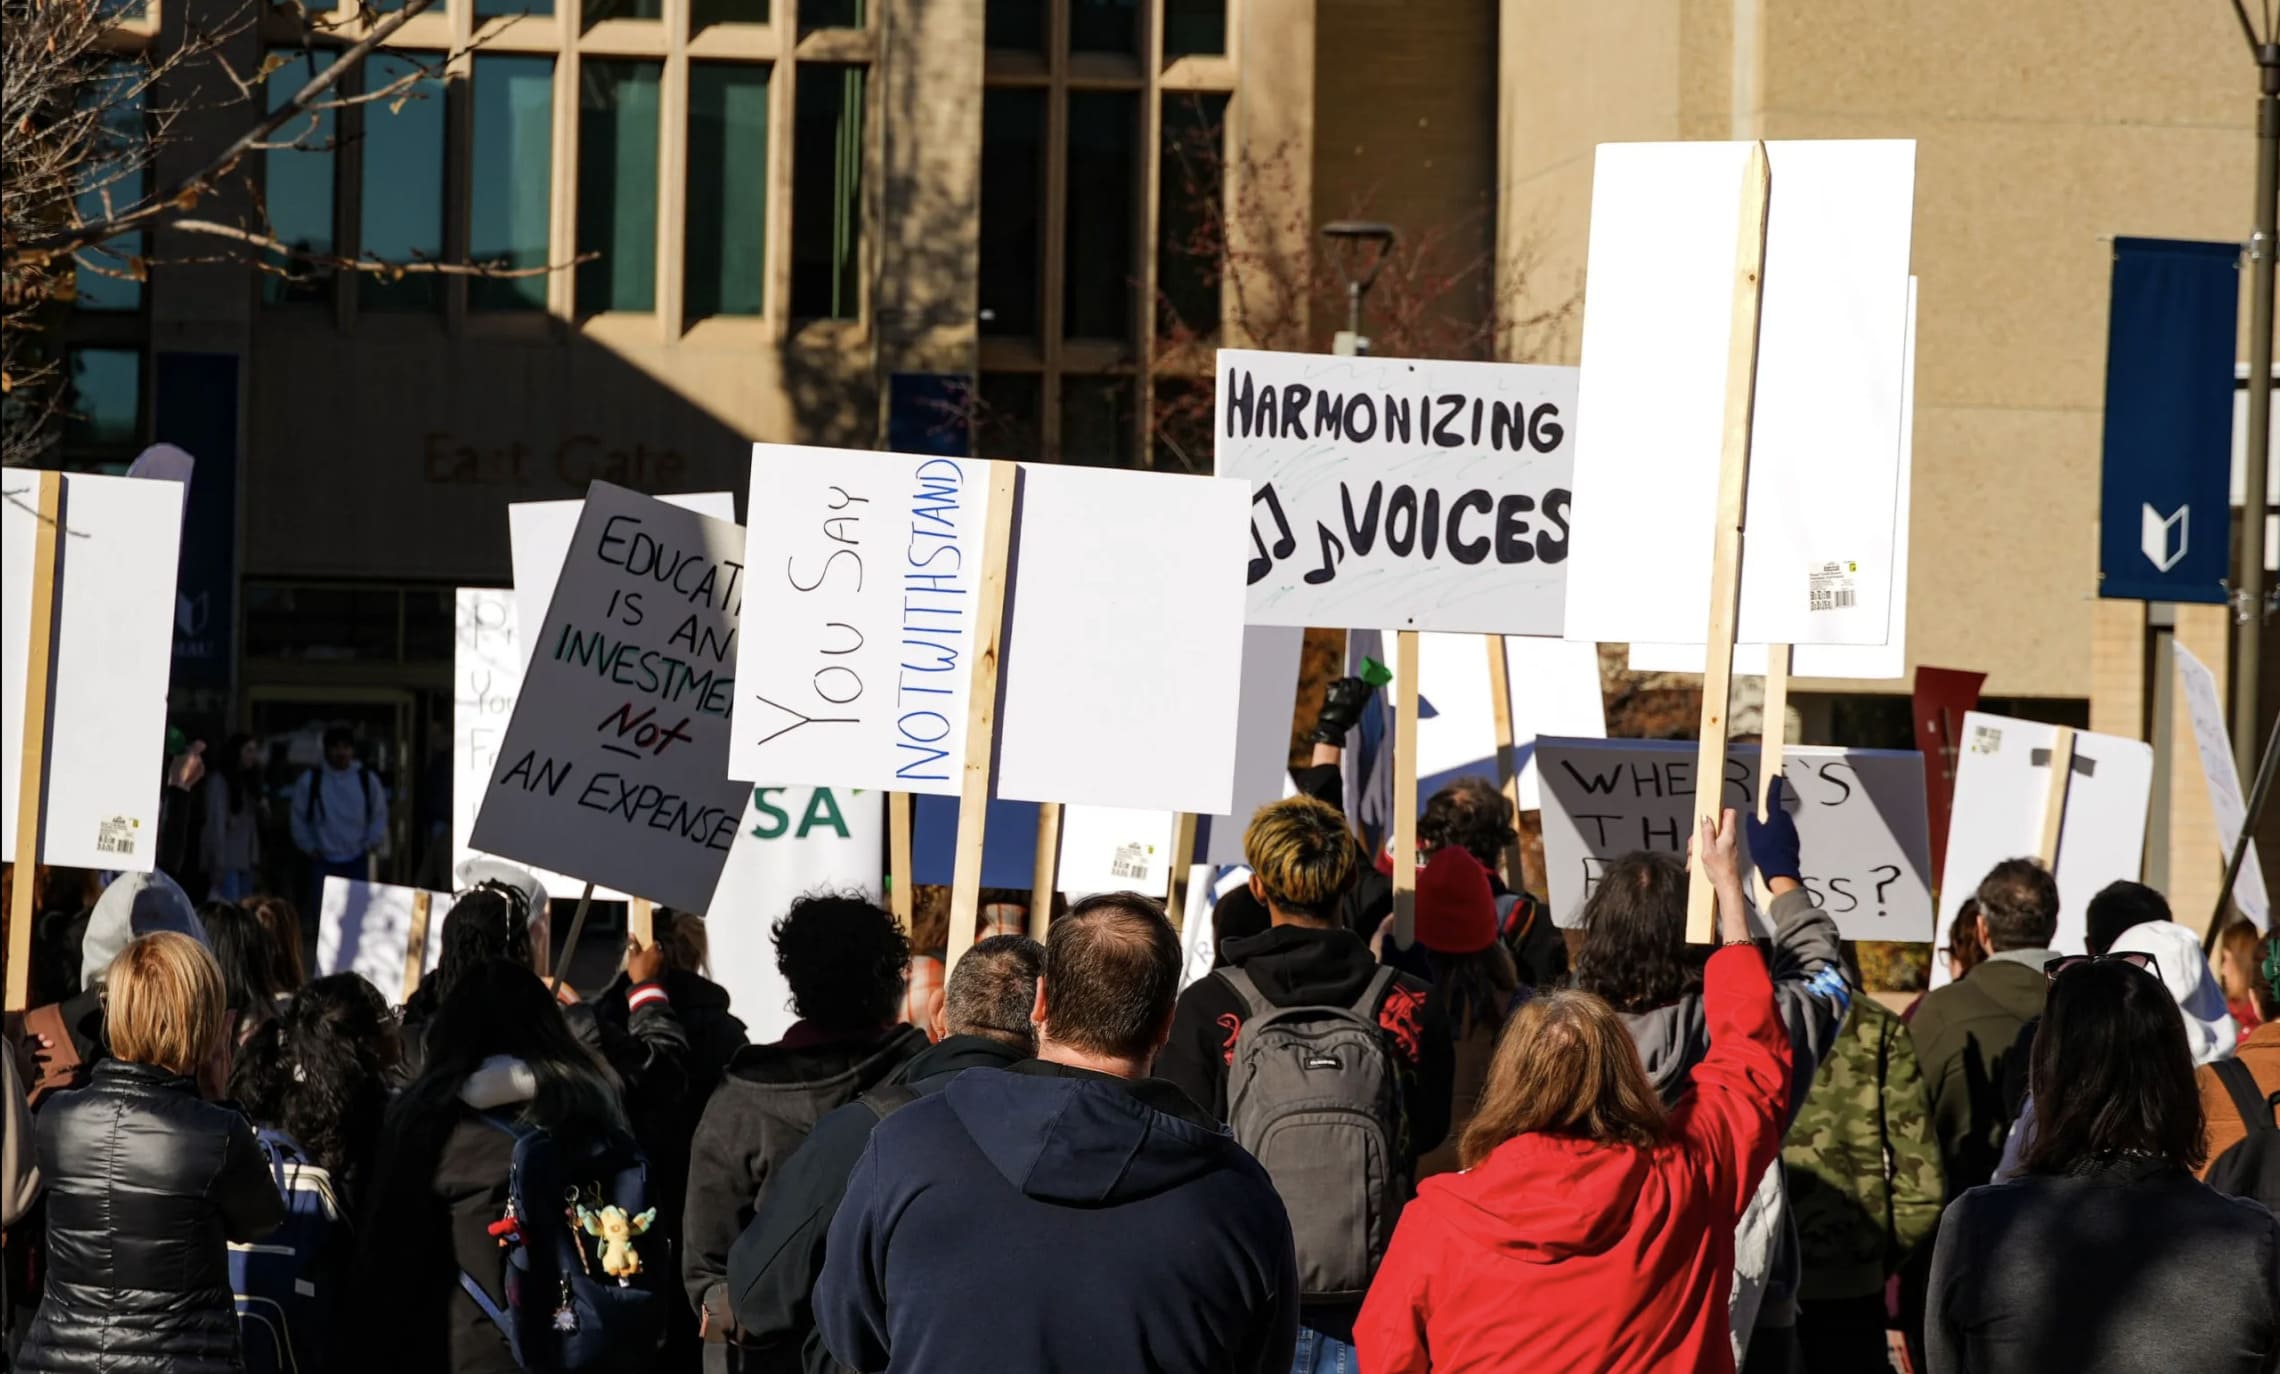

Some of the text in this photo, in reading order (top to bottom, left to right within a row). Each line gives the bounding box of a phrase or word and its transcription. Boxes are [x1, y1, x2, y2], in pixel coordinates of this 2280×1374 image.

[1226, 367, 1564, 453] HARMONIZING
[557, 434, 687, 488] Gate
[788, 486, 869, 592] SAY
[1341, 480, 1572, 565] VOICES
[607, 590, 736, 663] IS AN
[896, 459, 967, 781] NOTWITHSTAND
[500, 750, 742, 852] AN EXPENSE
[1562, 757, 1856, 806] WHER'S
[1574, 814, 1679, 853] TH
